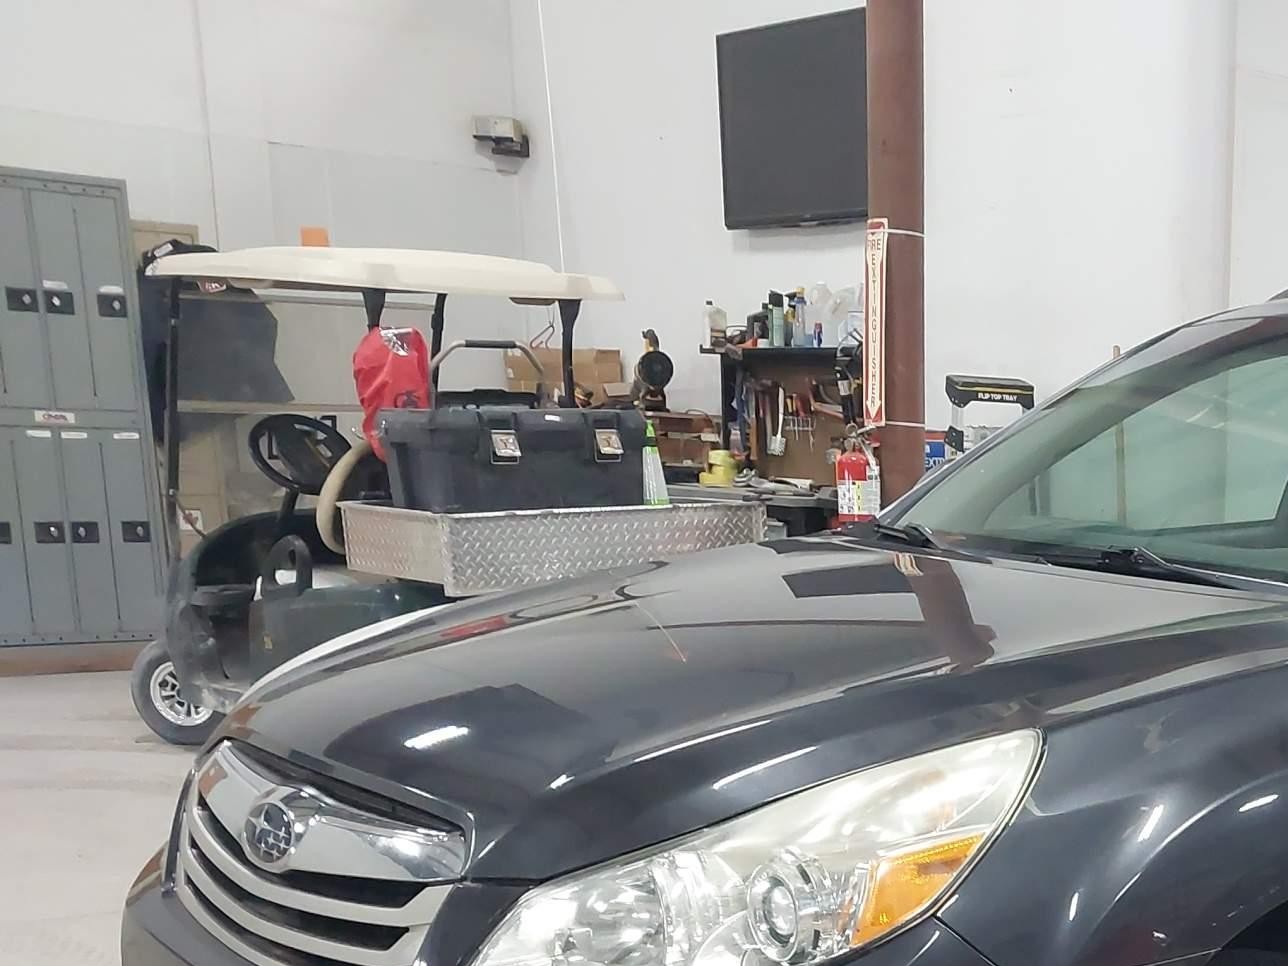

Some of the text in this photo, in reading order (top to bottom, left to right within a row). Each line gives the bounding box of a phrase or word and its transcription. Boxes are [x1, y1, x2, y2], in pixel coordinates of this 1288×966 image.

[977, 392, 1018, 402] FLIP TOP TRAY
